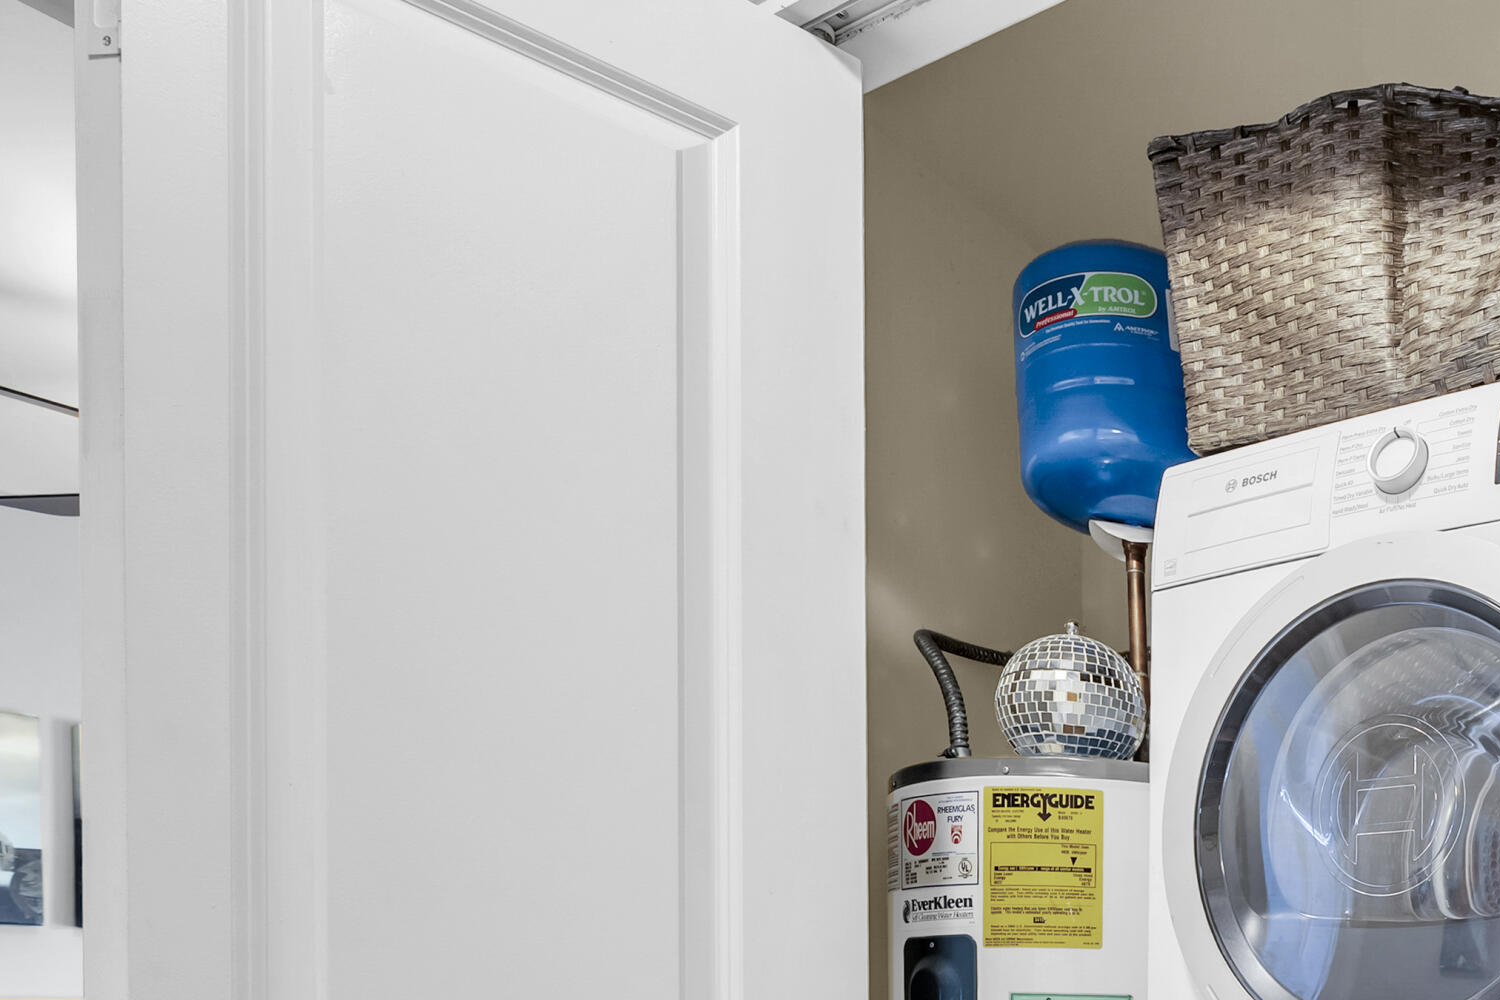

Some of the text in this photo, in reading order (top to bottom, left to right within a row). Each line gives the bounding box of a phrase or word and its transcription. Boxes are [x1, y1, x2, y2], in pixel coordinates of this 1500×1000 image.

[1023, 286, 1145, 323] WELL-X-TROL
[1098, 306, 1136, 314] by AMTROL
[1035, 309, 1074, 328] Professional
[1449, 418, 1465, 426] Cotton
[1241, 470, 1278, 487] BOSCH
[1433, 486, 1447, 494] Quick
[992, 793, 1095, 812] ENERGYGUIDE
[906, 803, 936, 849] Rheem
[947, 816, 964, 824] FURY
[988, 826, 1007, 834] Compare
[911, 895, 973, 912] EverKleen
